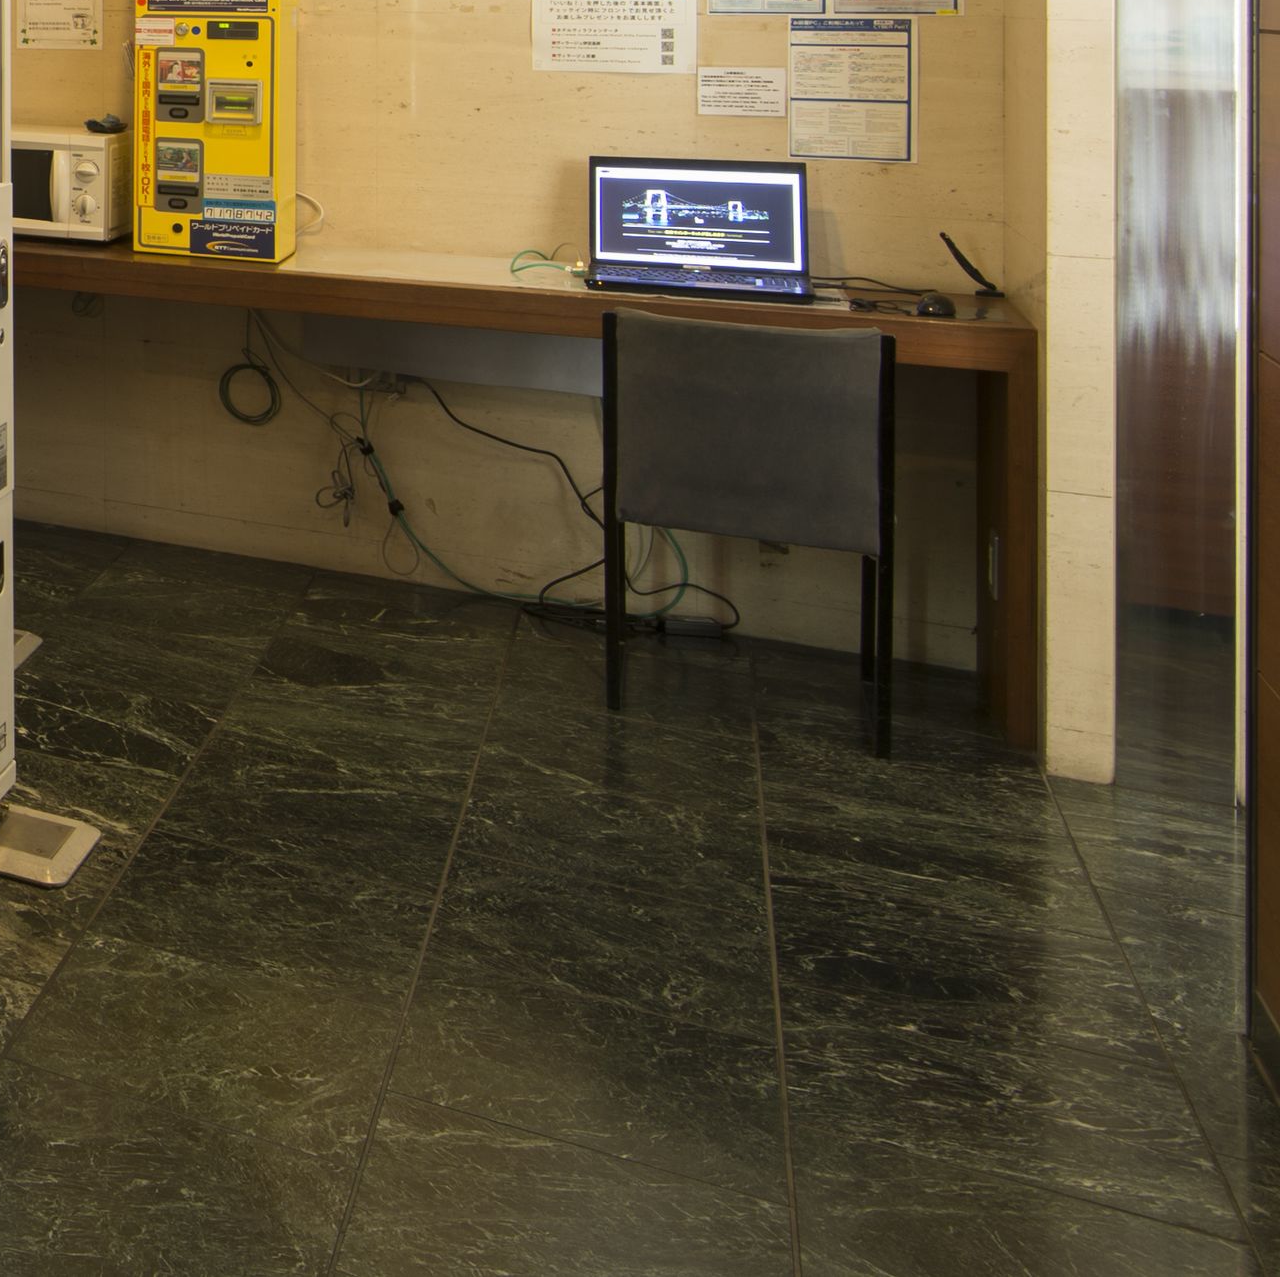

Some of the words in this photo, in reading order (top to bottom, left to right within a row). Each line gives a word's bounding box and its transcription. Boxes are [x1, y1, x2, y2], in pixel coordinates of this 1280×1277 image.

[191, 222, 273, 234] ワールドプリペイドカード
